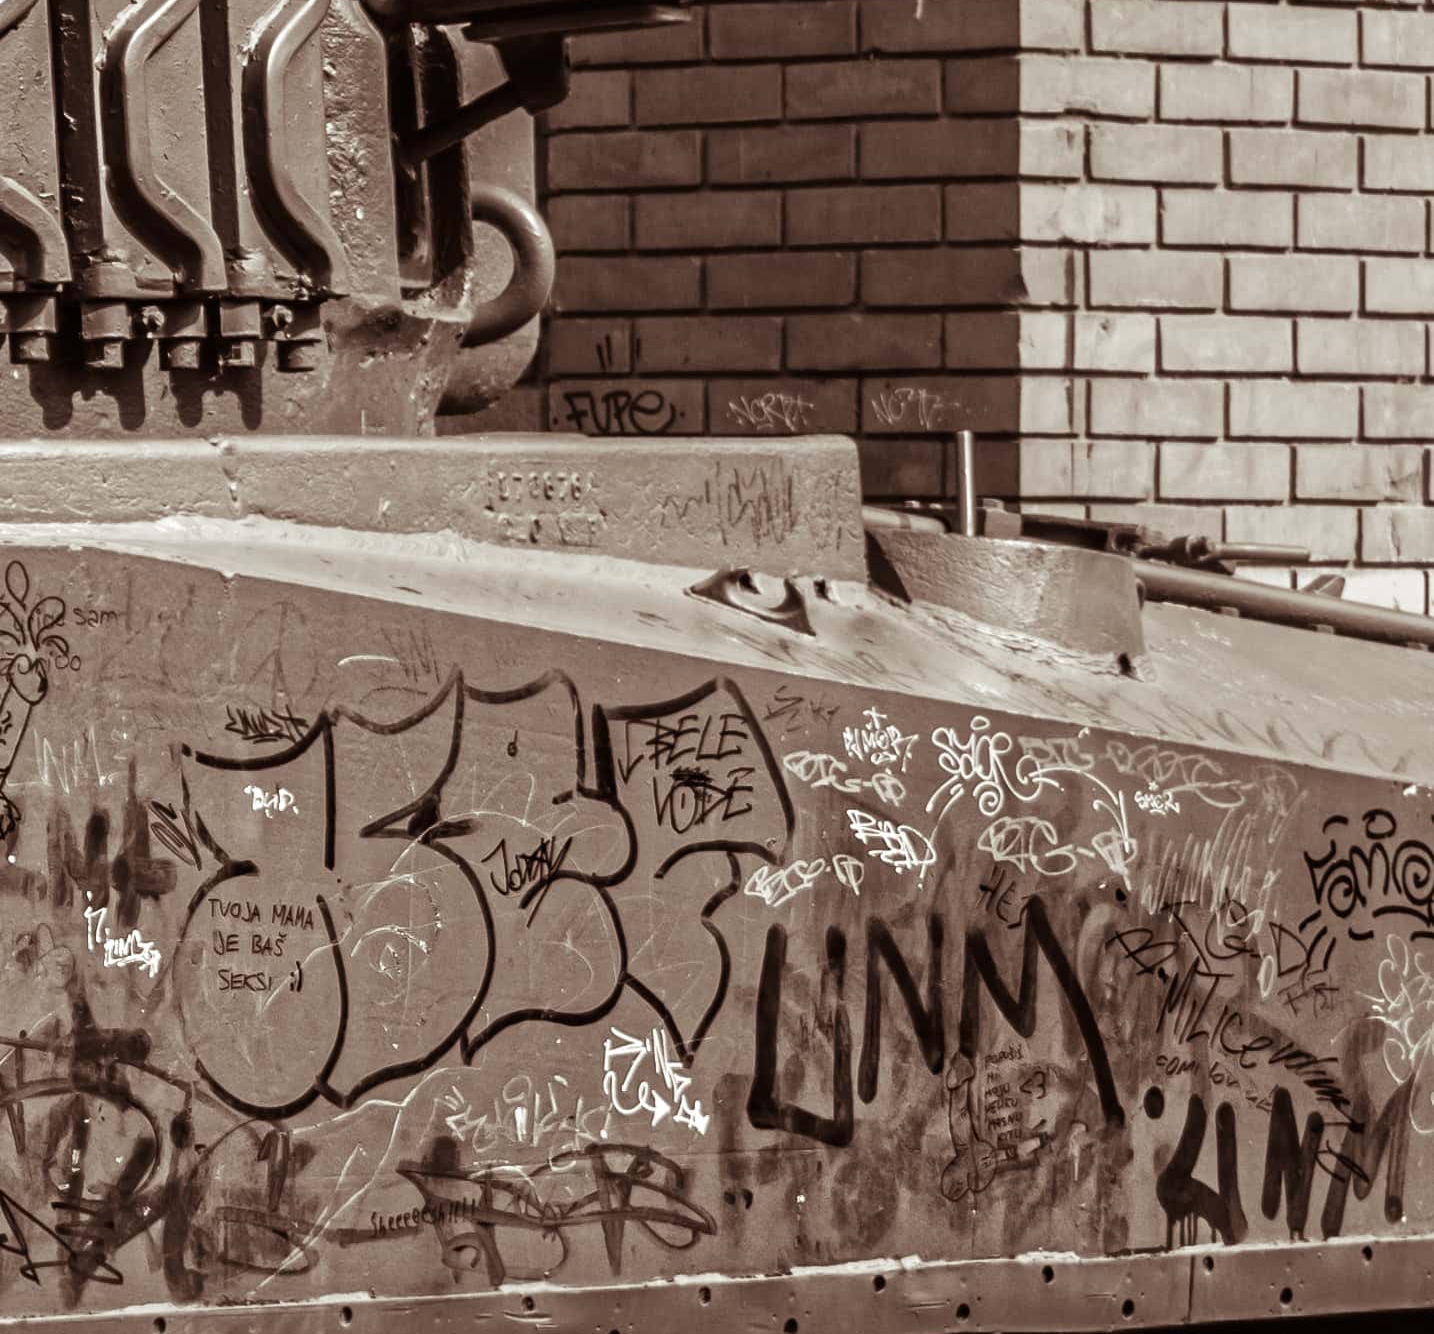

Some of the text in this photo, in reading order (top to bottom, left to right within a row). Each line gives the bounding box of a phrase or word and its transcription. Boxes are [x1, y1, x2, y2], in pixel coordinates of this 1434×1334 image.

[207, 898, 262, 924] TVOJA
[213, 929, 289, 957] JE BAŠ
[217, 968, 274, 993] SEKSI
